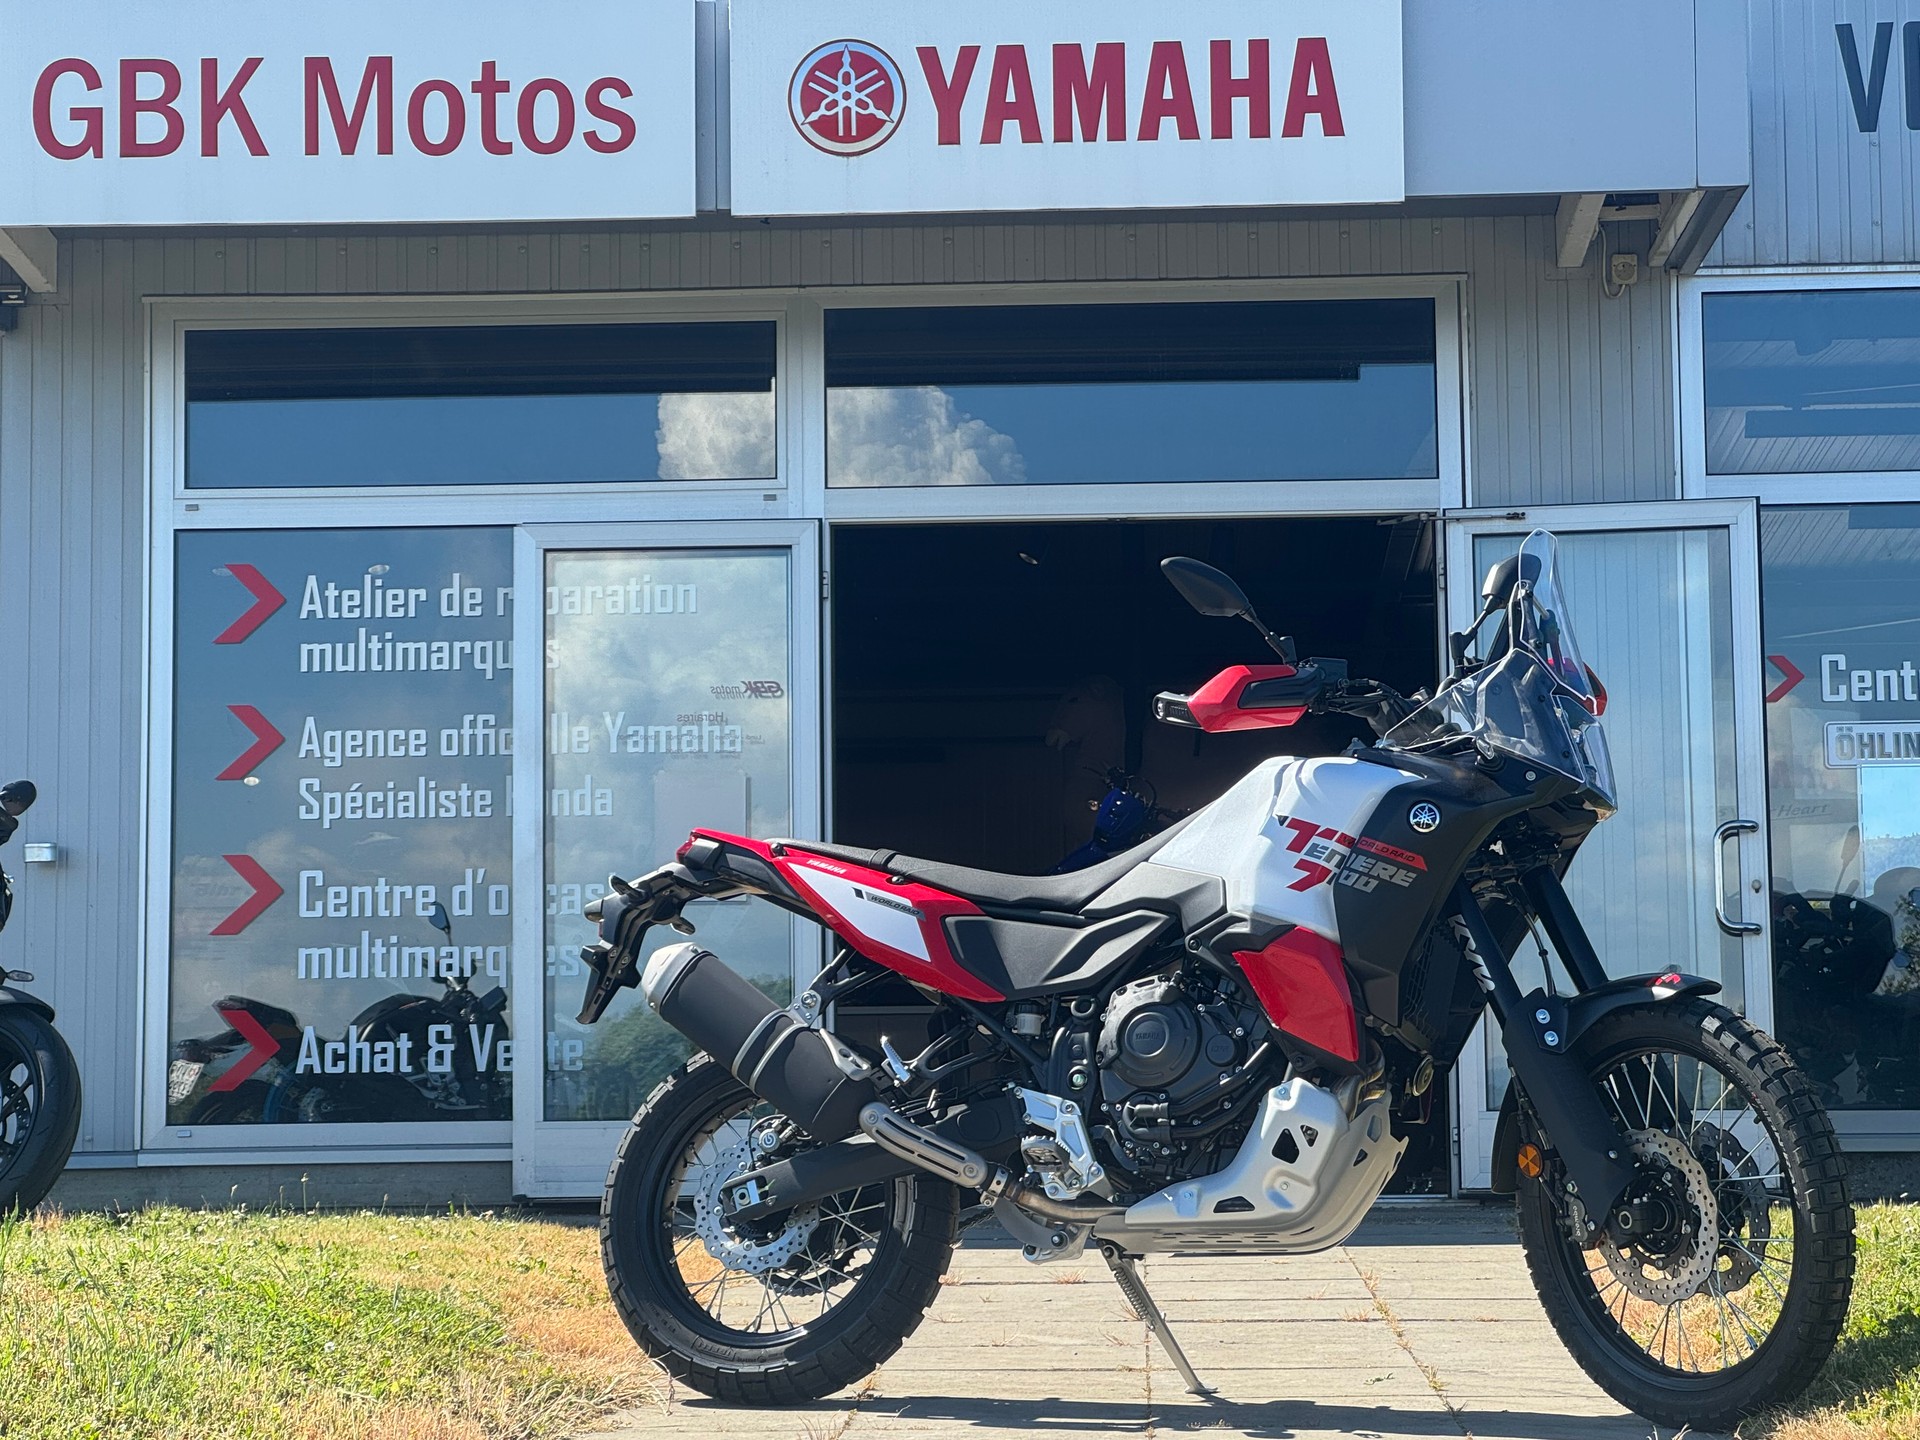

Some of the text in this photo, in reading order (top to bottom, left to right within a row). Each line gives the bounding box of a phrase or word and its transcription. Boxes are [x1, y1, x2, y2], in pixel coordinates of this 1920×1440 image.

[32, 55, 637, 161] GBK Motos
[915, 36, 1346, 146] YAMAHA
[300, 574, 428, 619] Atelier
[440, 572, 483, 618] de
[300, 627, 560, 680] multimarqus
[1820, 653, 1920, 702] Cent
[298, 711, 742, 767] Agence officlle Yamaha
[299, 774, 613, 829] Spécialiste nda
[806, 859, 847, 874] YAMAHA
[1389, 849, 1416, 862] RAID
[299, 869, 437, 918] Centre
[871, 895, 921, 916] WORLD RAID
[298, 930, 581, 988] multimarqes
[295, 1023, 584, 1074] Achat & Vete
